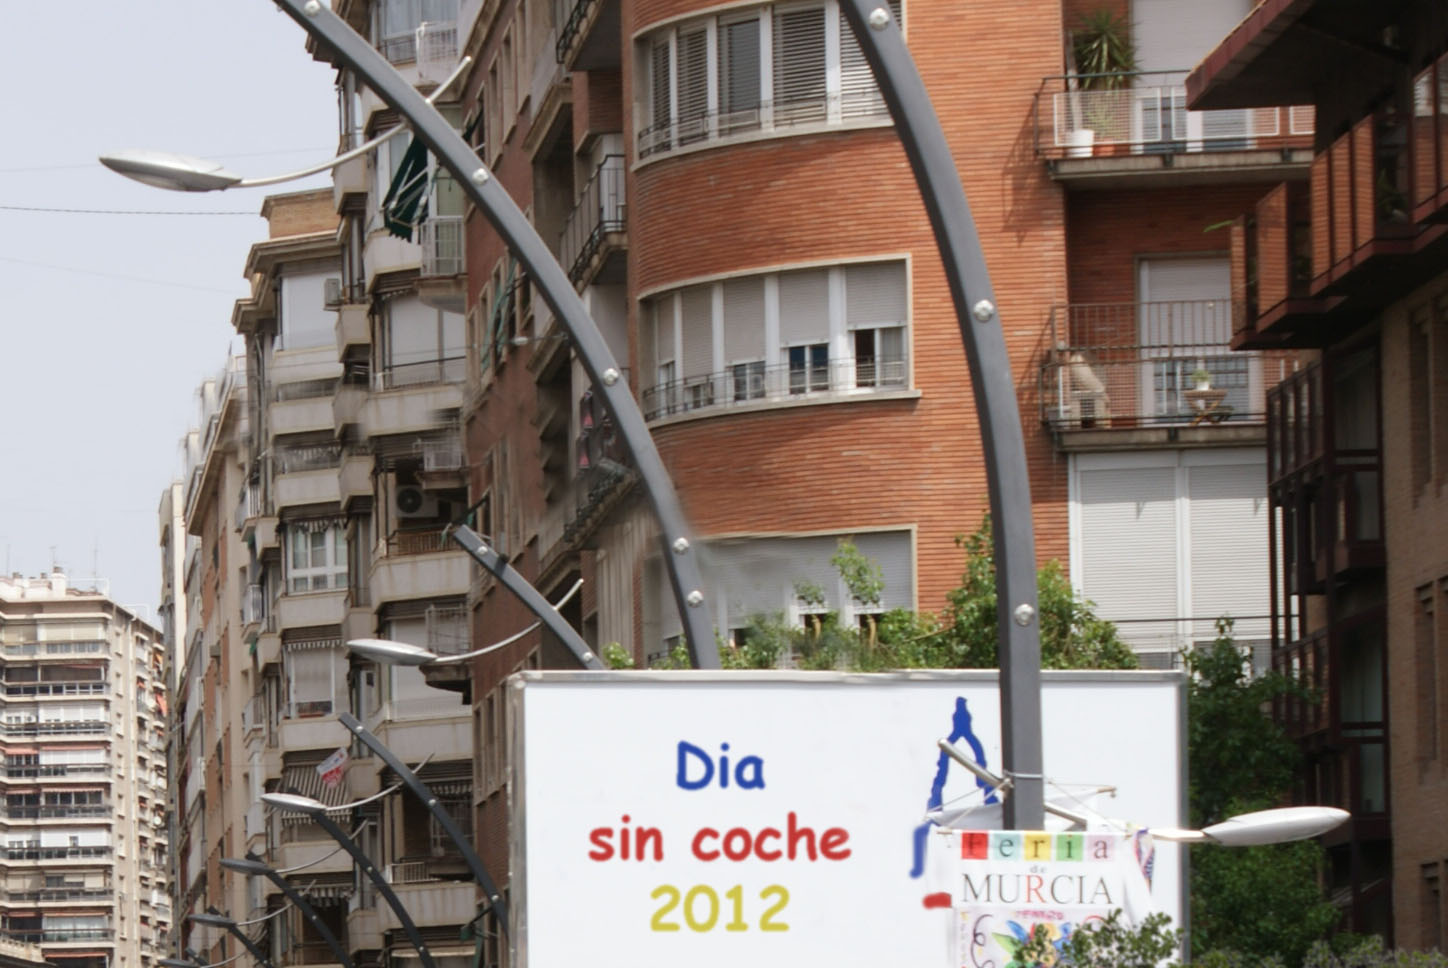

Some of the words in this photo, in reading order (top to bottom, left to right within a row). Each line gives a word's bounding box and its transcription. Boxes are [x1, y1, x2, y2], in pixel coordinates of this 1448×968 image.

[676, 740, 766, 791] Dia
[588, 814, 664, 862] sin
[691, 811, 852, 862] coche
[650, 884, 790, 933] 2012
[962, 873, 1114, 904] MURCIA
